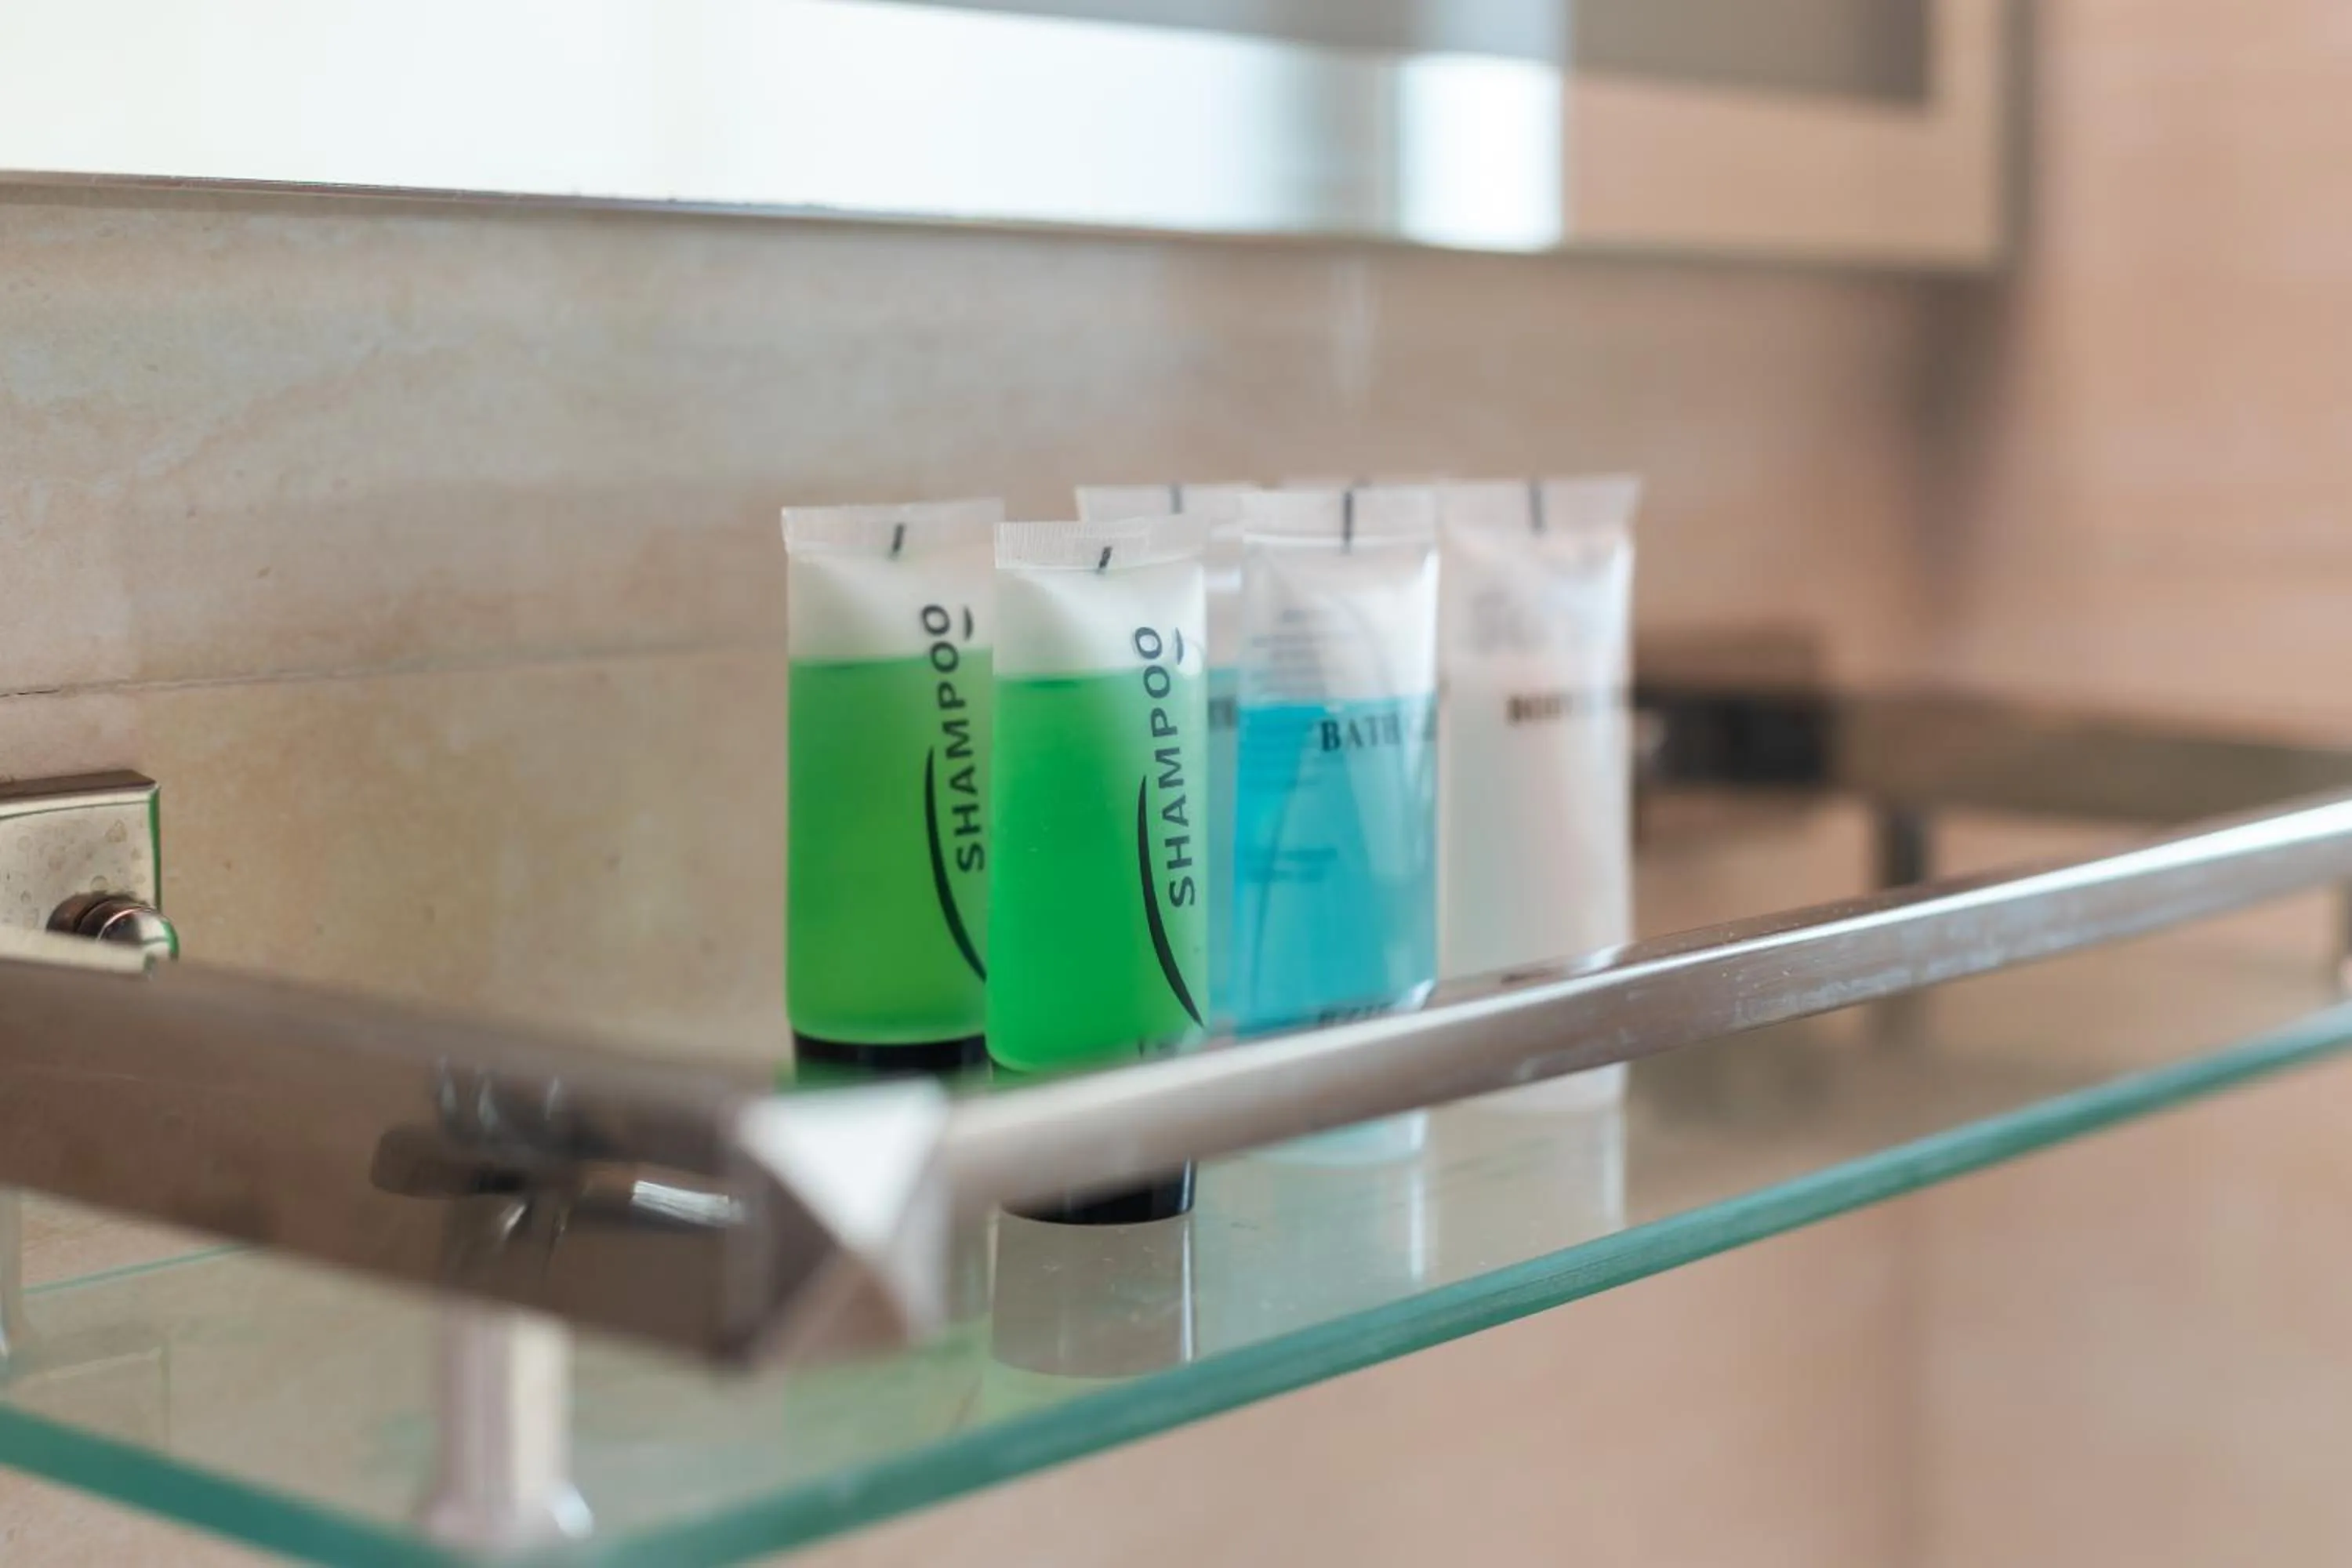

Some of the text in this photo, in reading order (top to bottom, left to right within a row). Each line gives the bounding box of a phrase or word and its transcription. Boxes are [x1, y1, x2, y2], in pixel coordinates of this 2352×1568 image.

[921, 604, 985, 873] SHAMPOO
[1134, 626, 1196, 907] SHAMPOO
[1320, 713, 1402, 752] BATH
